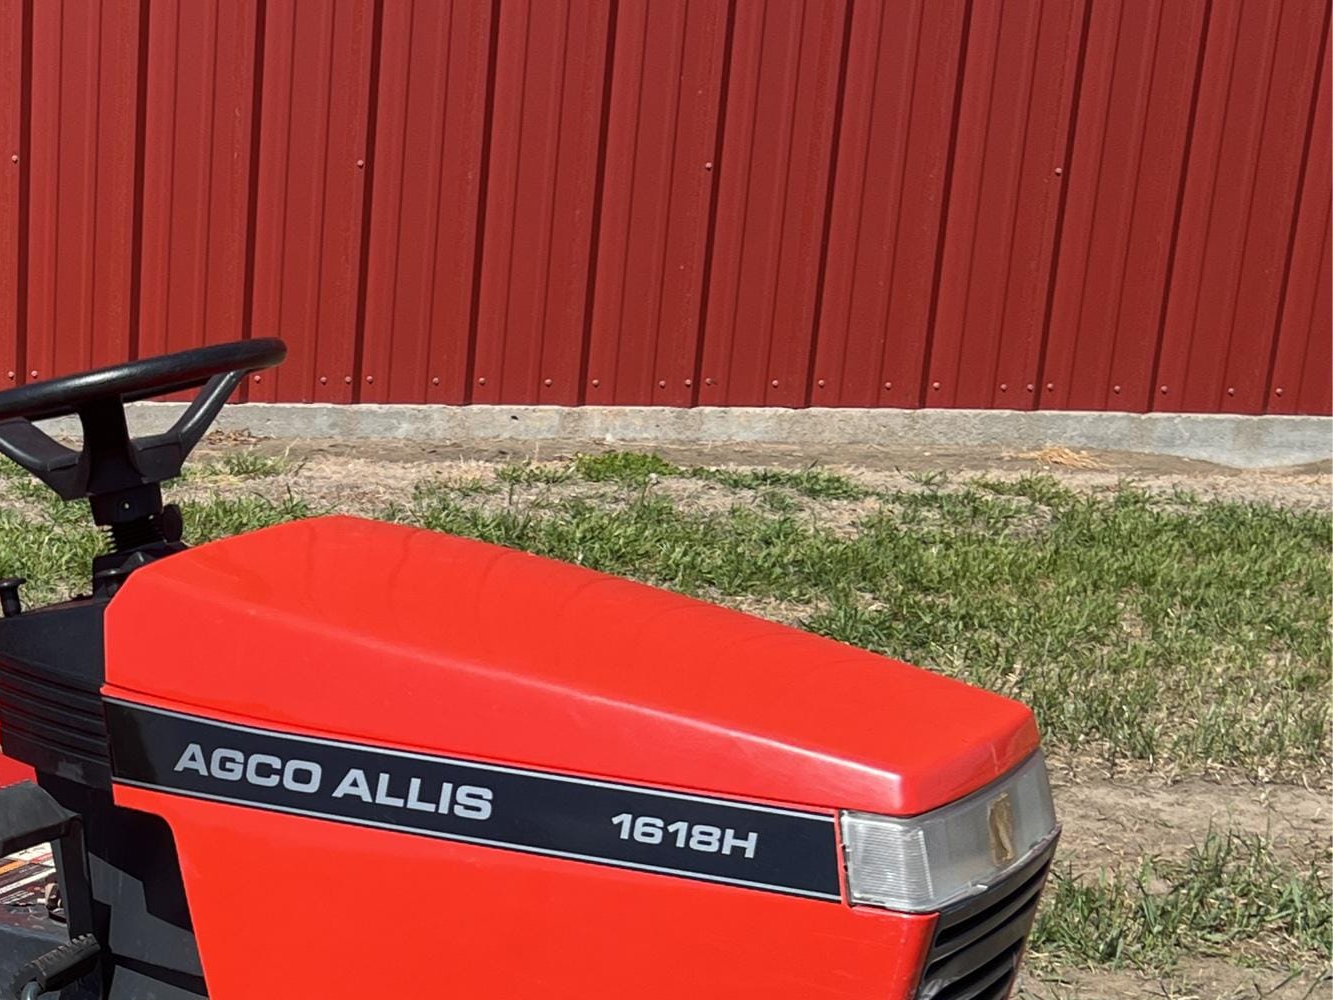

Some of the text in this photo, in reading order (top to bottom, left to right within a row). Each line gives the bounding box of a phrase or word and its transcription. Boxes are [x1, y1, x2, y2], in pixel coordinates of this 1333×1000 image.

[174, 743, 494, 821] AGCO ALLIS
[611, 813, 759, 859] 1618H
